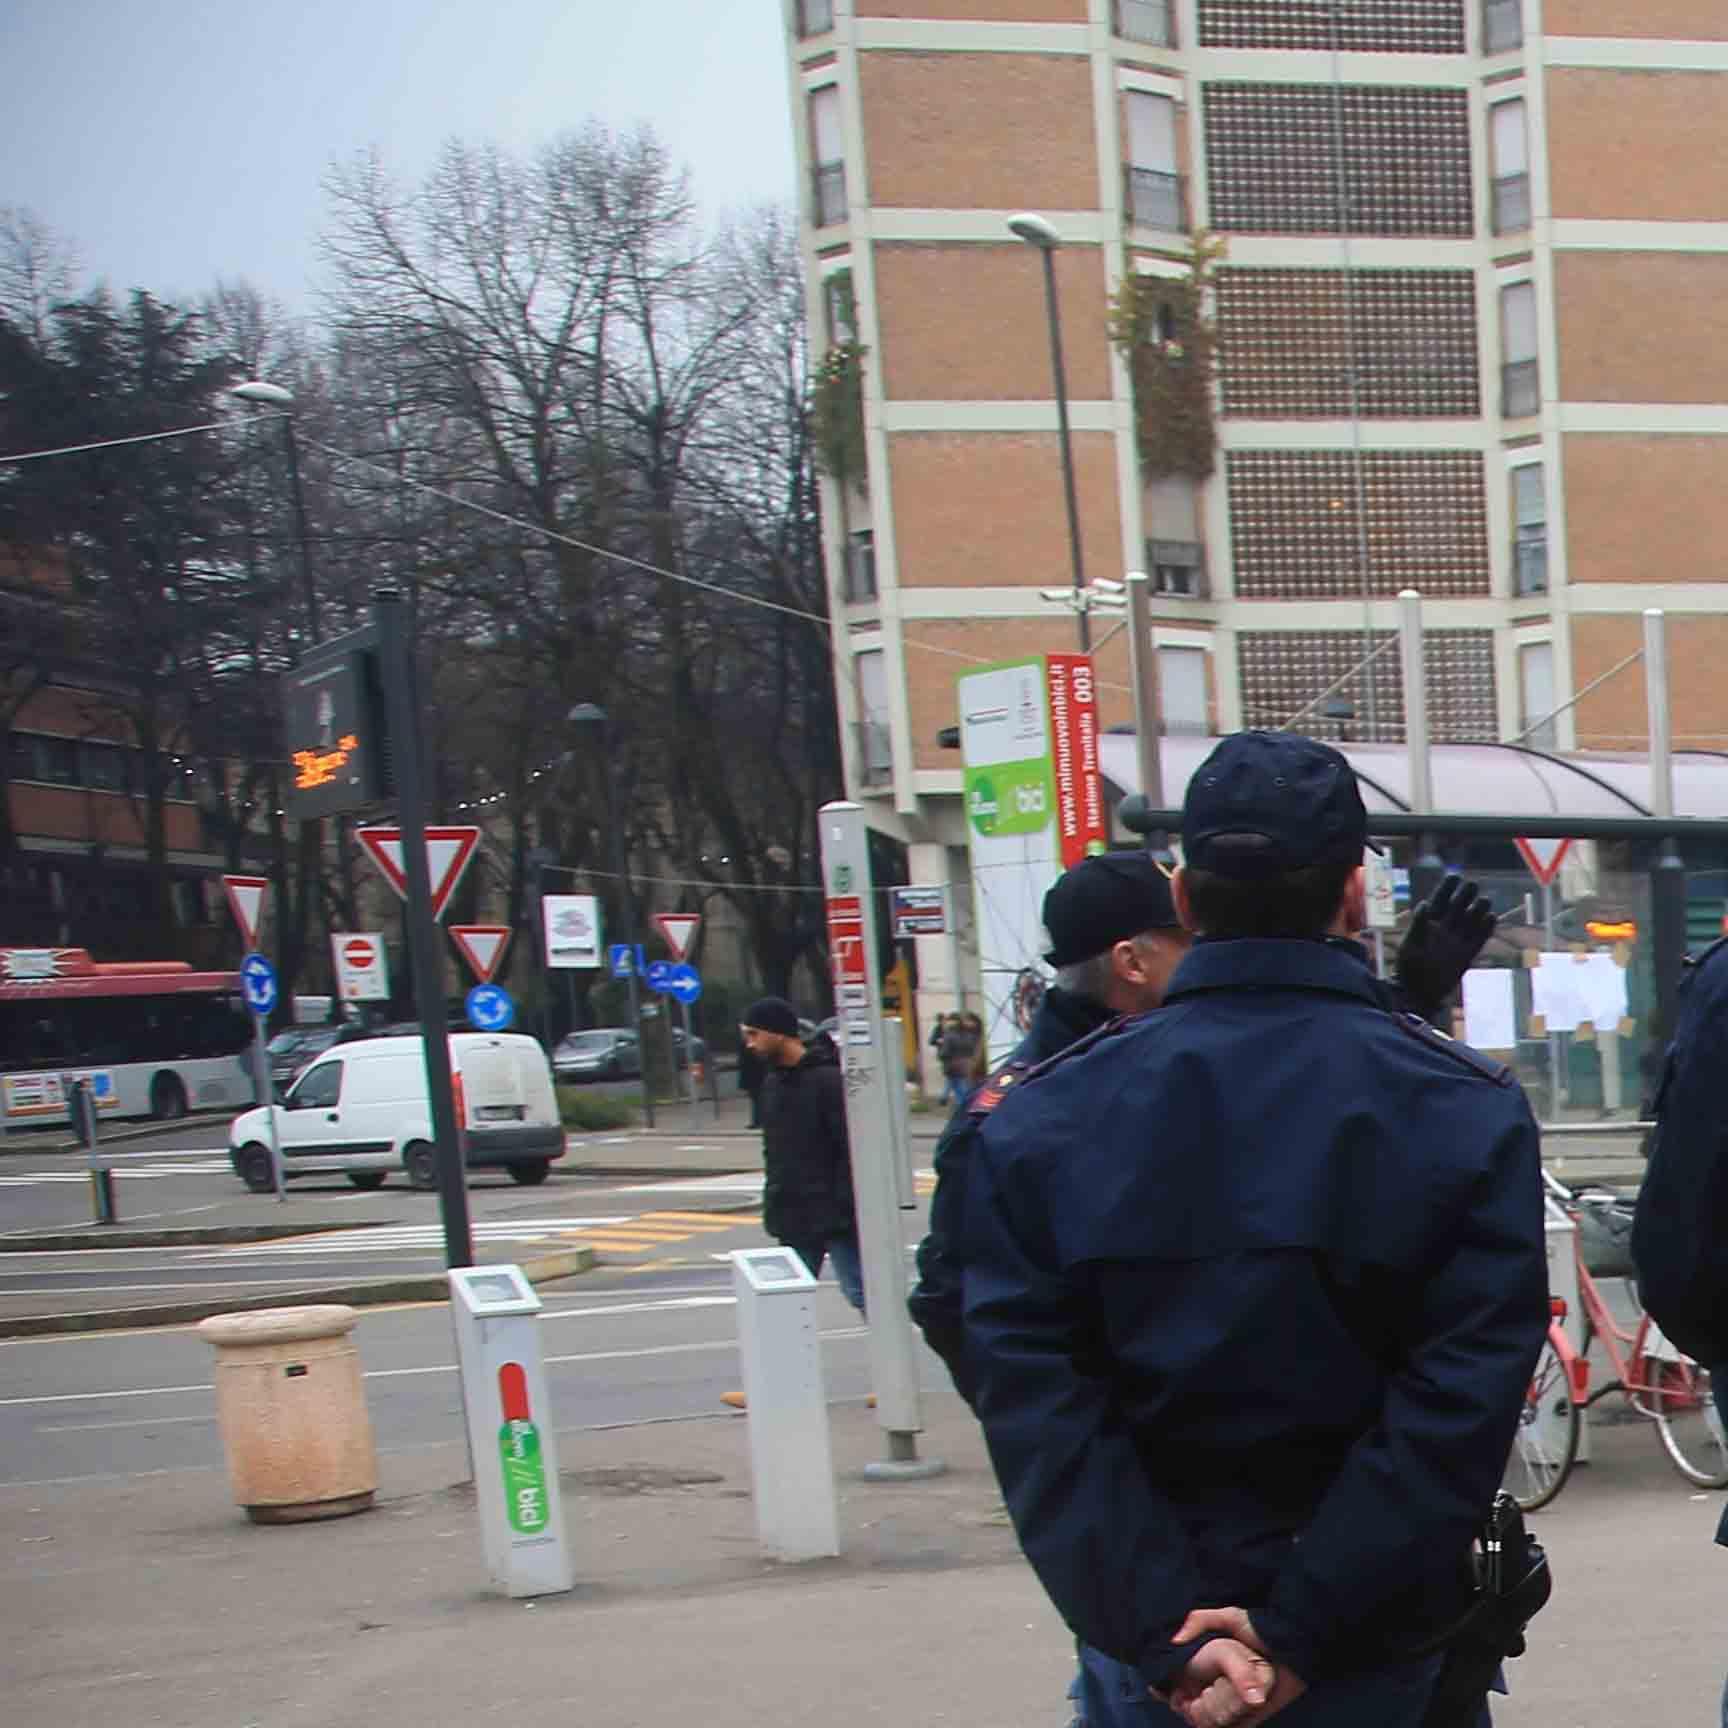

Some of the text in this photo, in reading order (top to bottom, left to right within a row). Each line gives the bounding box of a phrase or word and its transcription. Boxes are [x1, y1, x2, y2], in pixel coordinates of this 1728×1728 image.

[1072, 666, 1093, 703] 003
[1048, 662, 1078, 837] www.mimuovoinbici.it
[517, 1487, 543, 1527] bici
